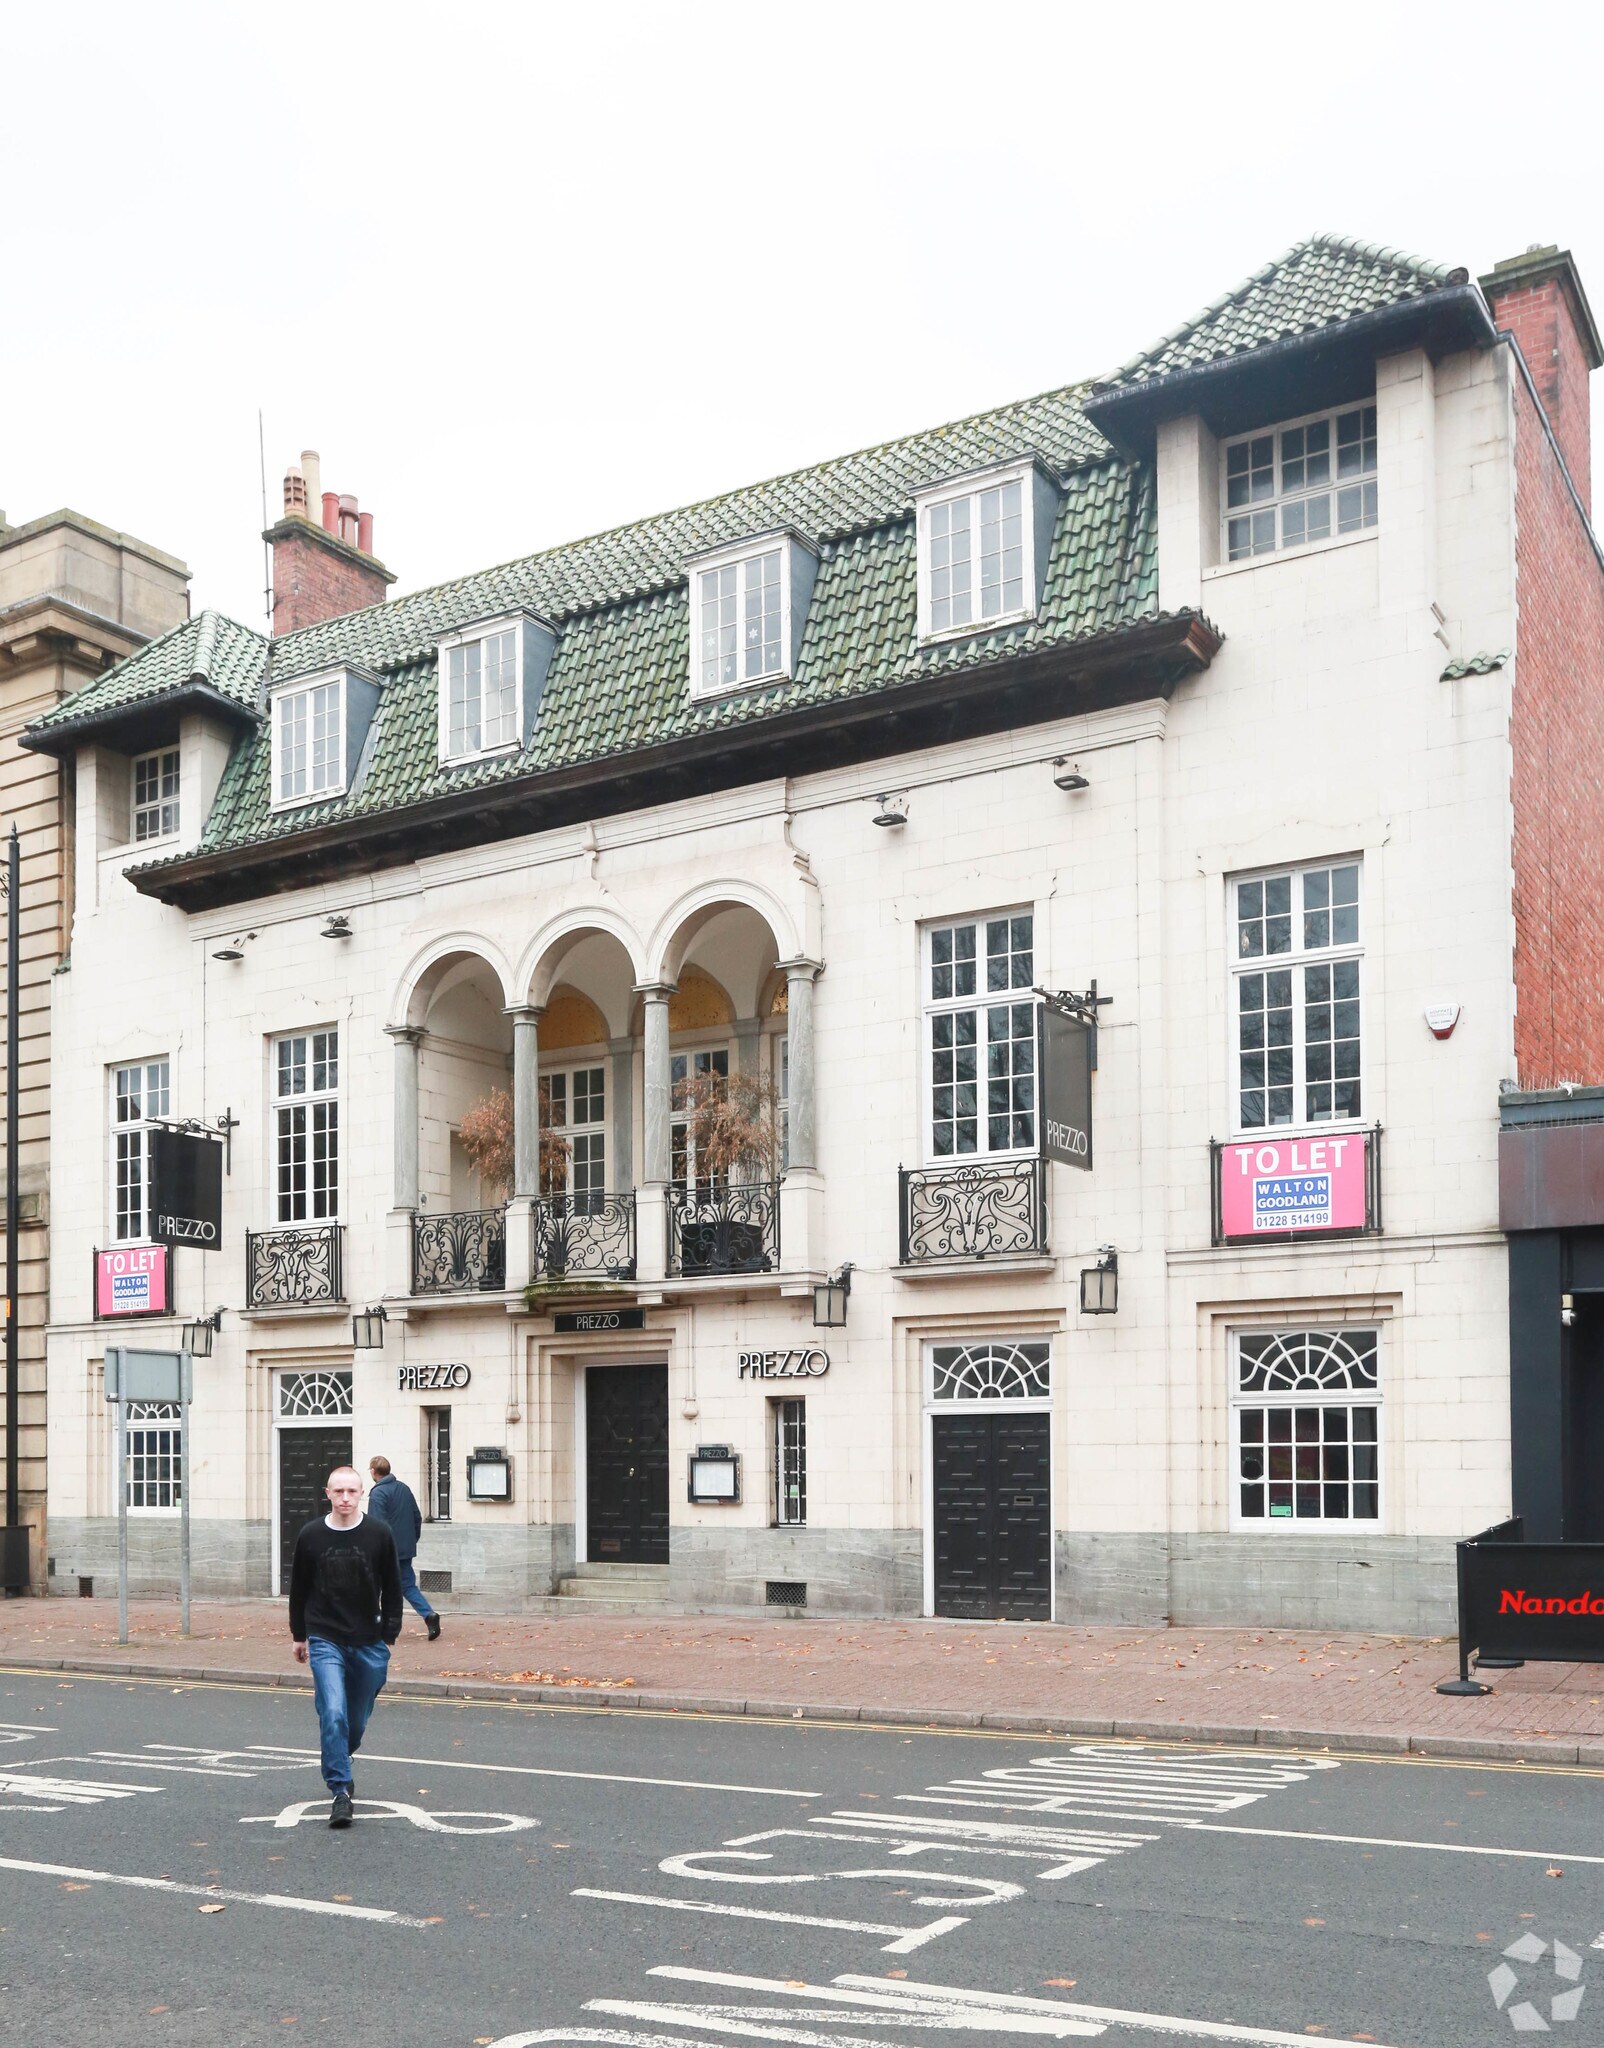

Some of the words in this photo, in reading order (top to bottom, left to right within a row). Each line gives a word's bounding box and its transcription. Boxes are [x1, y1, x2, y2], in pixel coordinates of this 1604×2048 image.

[1047, 1119, 1088, 1156] PREZZO
[1235, 1146, 1280, 1175] TO
[1291, 1140, 1348, 1172] LET
[1257, 1180, 1327, 1195] WALTON
[1257, 1194, 1327, 1209] GOODLAND
[158, 1215, 216, 1240] PREZZO
[1256, 1215, 1287, 1227] 01228
[1291, 1213, 1329, 1225] 514199
[104, 1254, 125, 1274] TO
[130, 1250, 157, 1272] LET
[114, 1277, 148, 1288] WALTON
[114, 1286, 148, 1298] GOODLAND
[114, 1301, 129, 1310] 01228
[130, 1299, 148, 1308] 514199
[576, 1314, 620, 1329] PREZZO
[738, 1349, 830, 1379] PREZZO
[398, 1363, 471, 1390] PREZZO
[477, 1451, 501, 1460] PREZZO
[700, 1449, 727, 1459] PREZZO
